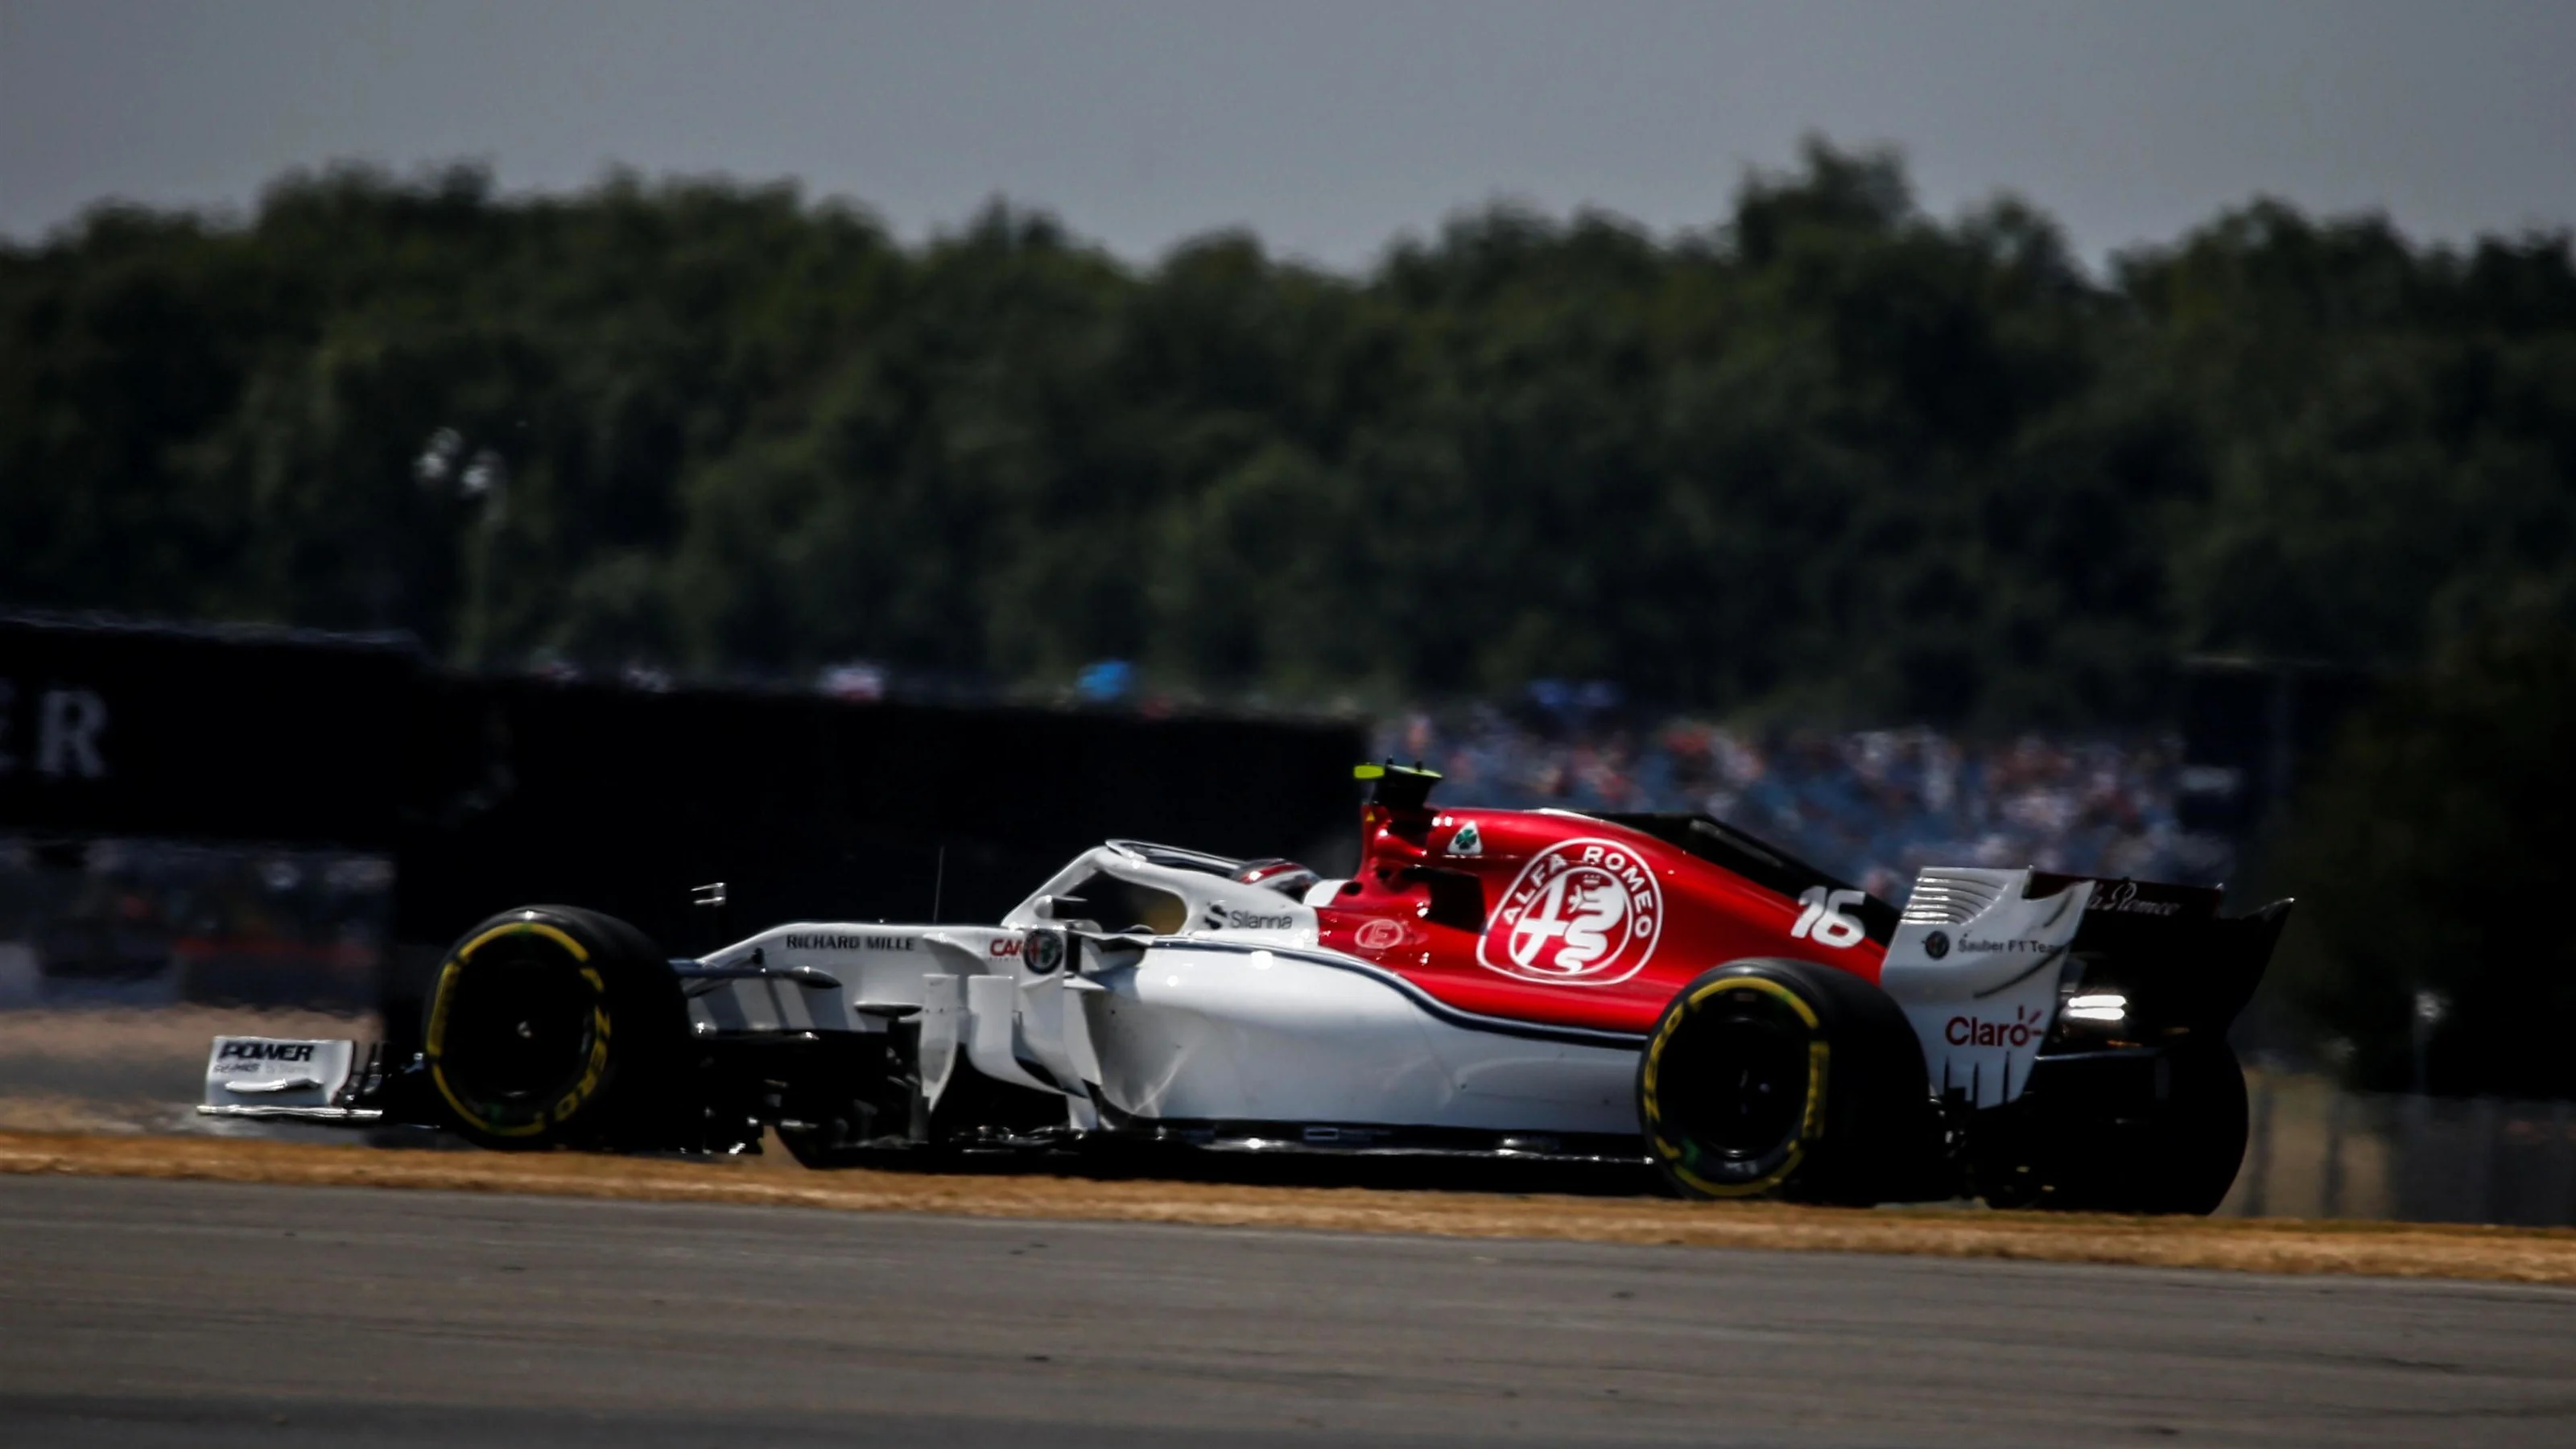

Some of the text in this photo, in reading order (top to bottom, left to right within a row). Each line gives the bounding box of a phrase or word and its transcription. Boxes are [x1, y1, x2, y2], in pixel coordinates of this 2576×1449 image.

[1502, 845, 1654, 940] ALFA ROMEO
[1229, 910, 1293, 930] Silanna
[1790, 884, 1866, 948] 16
[786, 934, 915, 952] RICHARD MILLE
[1945, 1016, 2029, 1046] Claro
[219, 1041, 315, 1063] POWER
